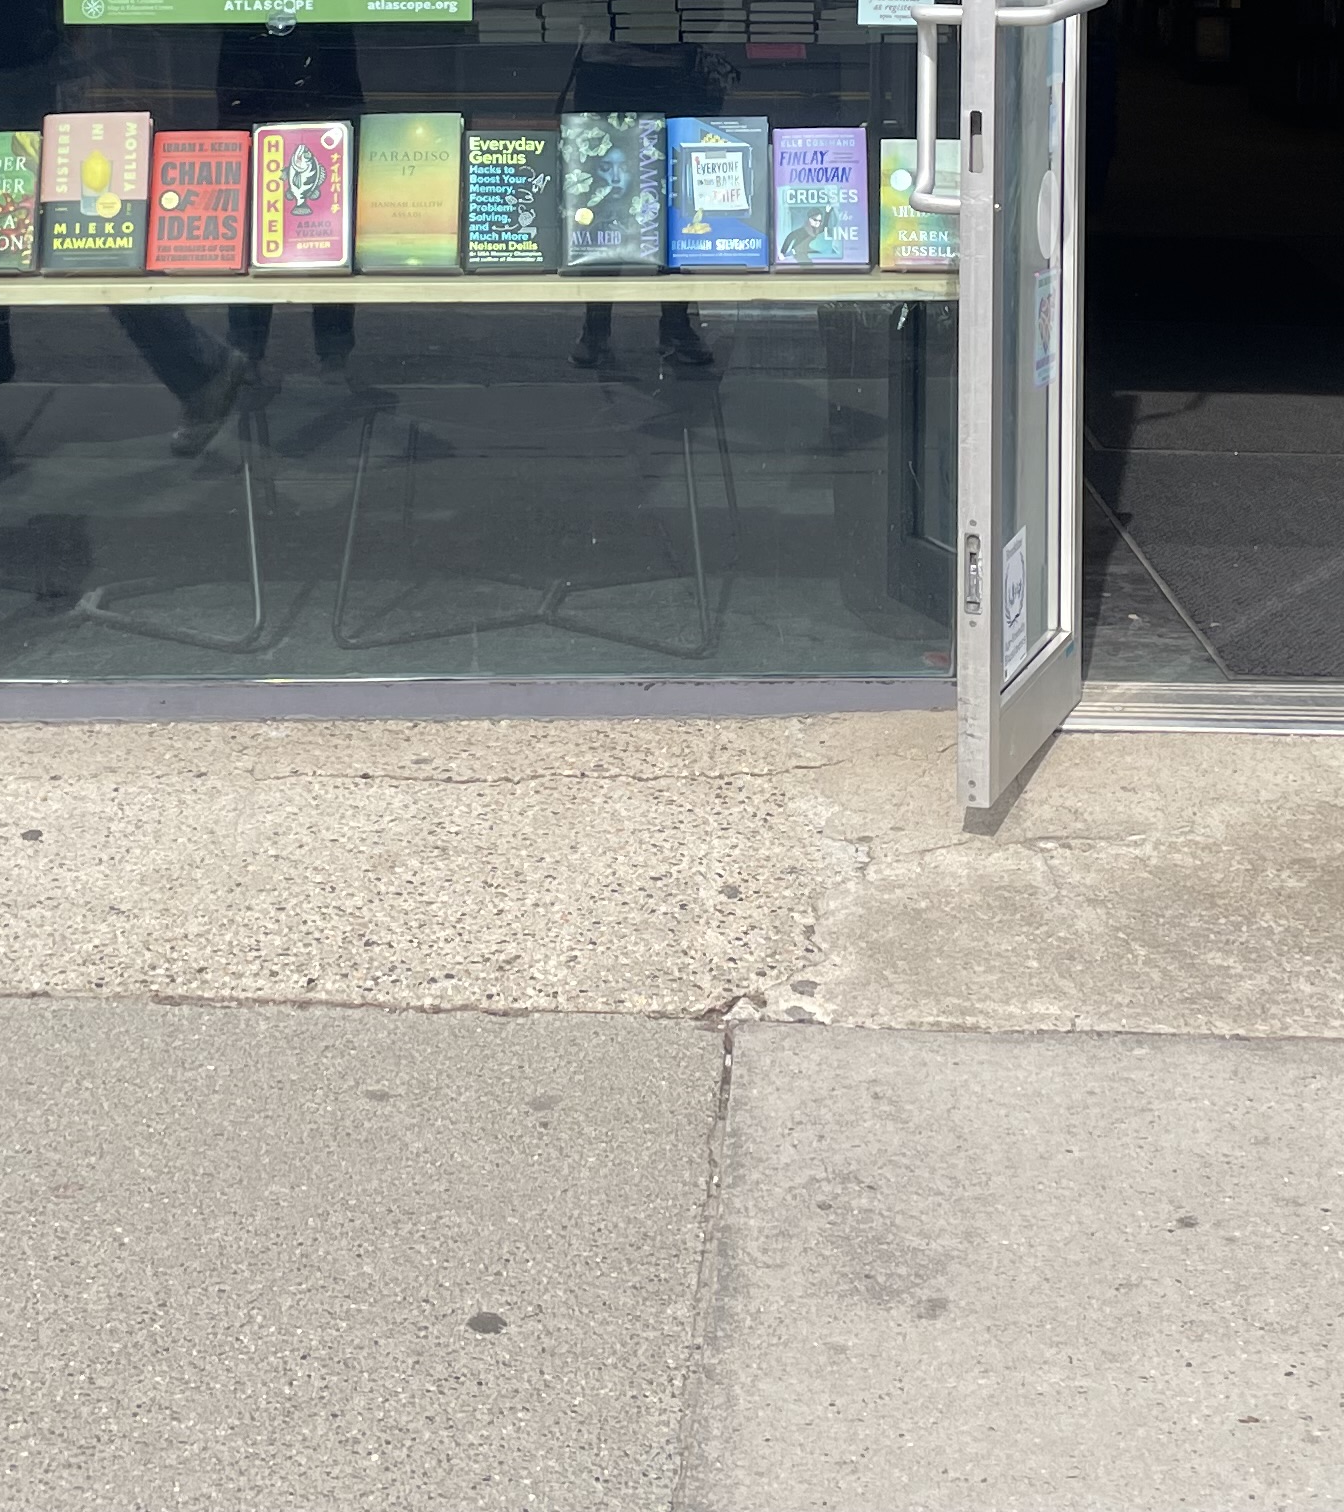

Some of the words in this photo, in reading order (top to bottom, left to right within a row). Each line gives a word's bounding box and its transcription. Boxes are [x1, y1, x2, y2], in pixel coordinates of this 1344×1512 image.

[367, 0, 458, 13] atlascope.org
[91, 123, 104, 141] IN
[469, 137, 545, 154] Everyday
[56, 123, 71, 194] SISTERS
[123, 122, 138, 193] YELLOW
[369, 151, 450, 162] PARADISO
[469, 151, 527, 165] Genius
[779, 150, 829, 166] FINLAY
[161, 161, 242, 186] CHAIN
[401, 165, 416, 176] 17
[469, 165, 502, 174] Hacks
[503, 166, 515, 174] to
[789, 167, 853, 183] DONOVAN
[469, 175, 501, 184] Boost
[502, 175, 527, 184] Your
[265, 139, 282, 254] HOOKED
[469, 185, 516, 195] Memory,
[786, 189, 859, 203] CROSSES
[469, 194, 504, 204] Focus,
[469, 203, 516, 212] Problem-
[469, 213, 512, 223] Solving,
[54, 221, 135, 234] MIEKO
[157, 215, 239, 241] IDEAS
[469, 222, 489, 231] and
[469, 232, 499, 241] Much
[501, 232, 529, 241] More
[570, 231, 594, 245] AVA
[597, 231, 622, 244] REID
[824, 226, 859, 241] LINE
[898, 230, 949, 242] KAREN
[53, 237, 133, 250] KAWAKAMI
[297, 240, 331, 249] BUTTER
[469, 241, 506, 251] Nelson
[508, 241, 538, 251] Dellis
